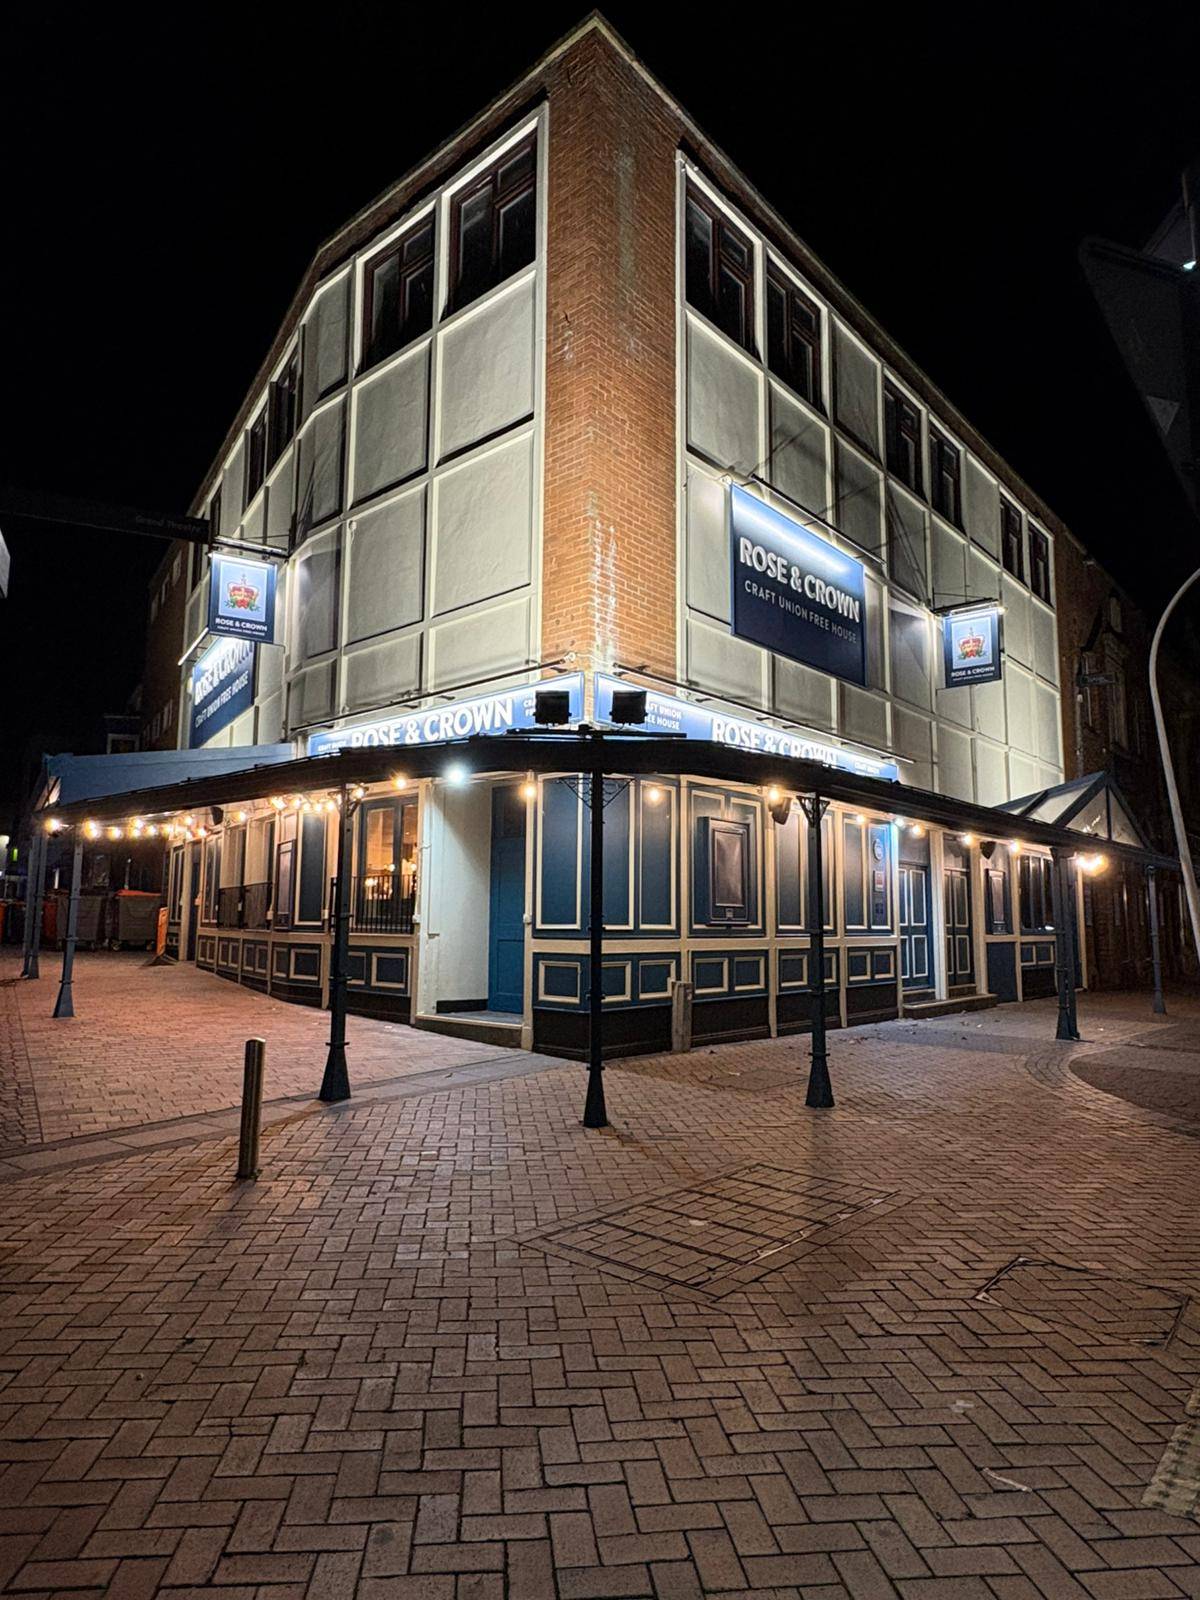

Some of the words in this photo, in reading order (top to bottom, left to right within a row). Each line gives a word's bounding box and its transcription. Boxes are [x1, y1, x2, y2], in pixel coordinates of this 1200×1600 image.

[739, 536, 788, 585] ROSE
[790, 565, 802, 593] &
[804, 573, 861, 623] CROWN
[215, 616, 234, 627] ROSE
[235, 620, 240, 628] &
[241, 621, 268, 632] CROWN
[744, 579, 775, 604] CRAFT
[778, 595, 808, 620] UNION
[809, 611, 830, 631] FREE
[831, 622, 857, 644] HOUSE
[207, 695, 220, 718] UNION
[220, 686, 232, 706] FREE
[231, 669, 249, 696] HOUSE
[951, 669, 966, 678] ROSE
[972, 665, 995, 675] CROWN
[351, 723, 402, 747] ROSE
[404, 718, 421, 745] &
[423, 697, 514, 742] CROWN
[656, 715, 681, 731] HOUSE
[659, 704, 682, 720] UNION
[712, 718, 761, 749] ROSE
[764, 733, 777, 753] &
[778, 738, 838, 766] CROWN
